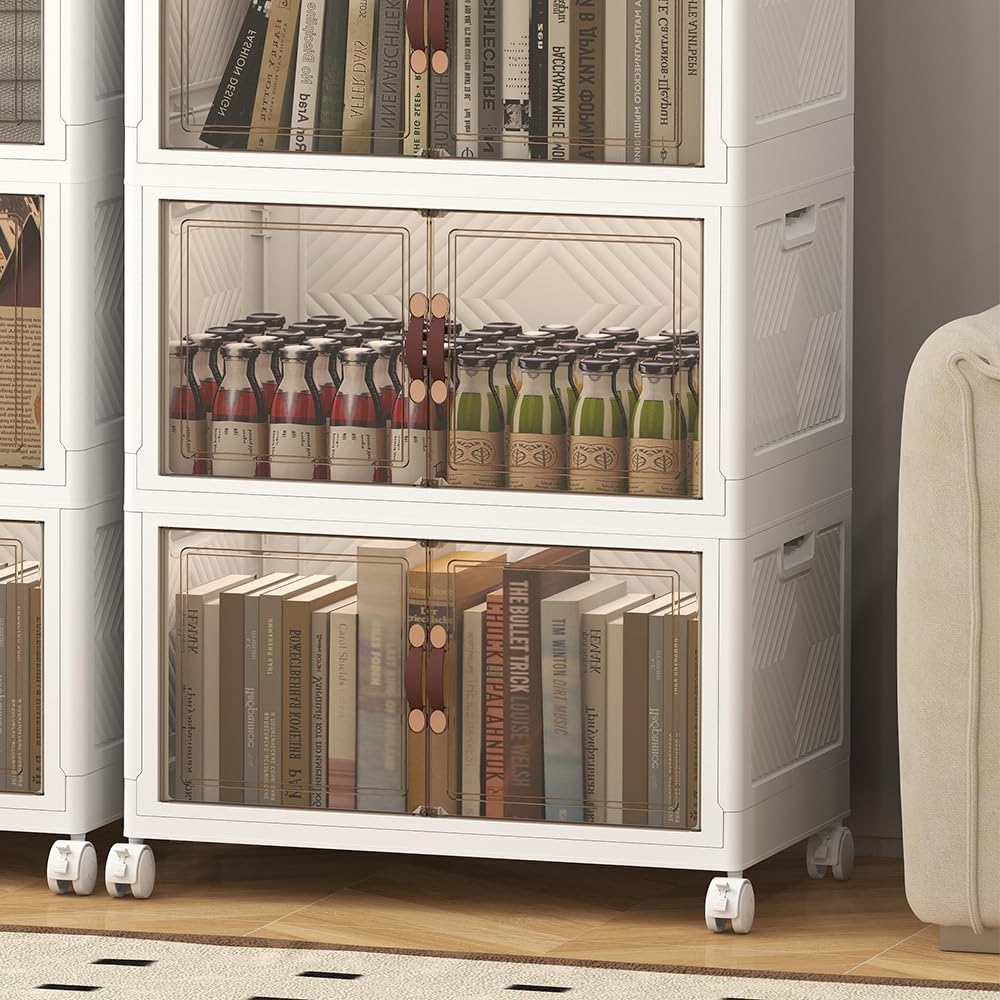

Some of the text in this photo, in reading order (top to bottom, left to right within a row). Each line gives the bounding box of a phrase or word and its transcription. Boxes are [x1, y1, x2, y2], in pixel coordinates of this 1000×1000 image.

[487, 602, 503, 658] CHUCK
[508, 580, 529, 693] THE BULLET TRICK
[551, 619, 566, 676] TIM WINTON
[553, 679, 568, 735] DIRT MUSIC
